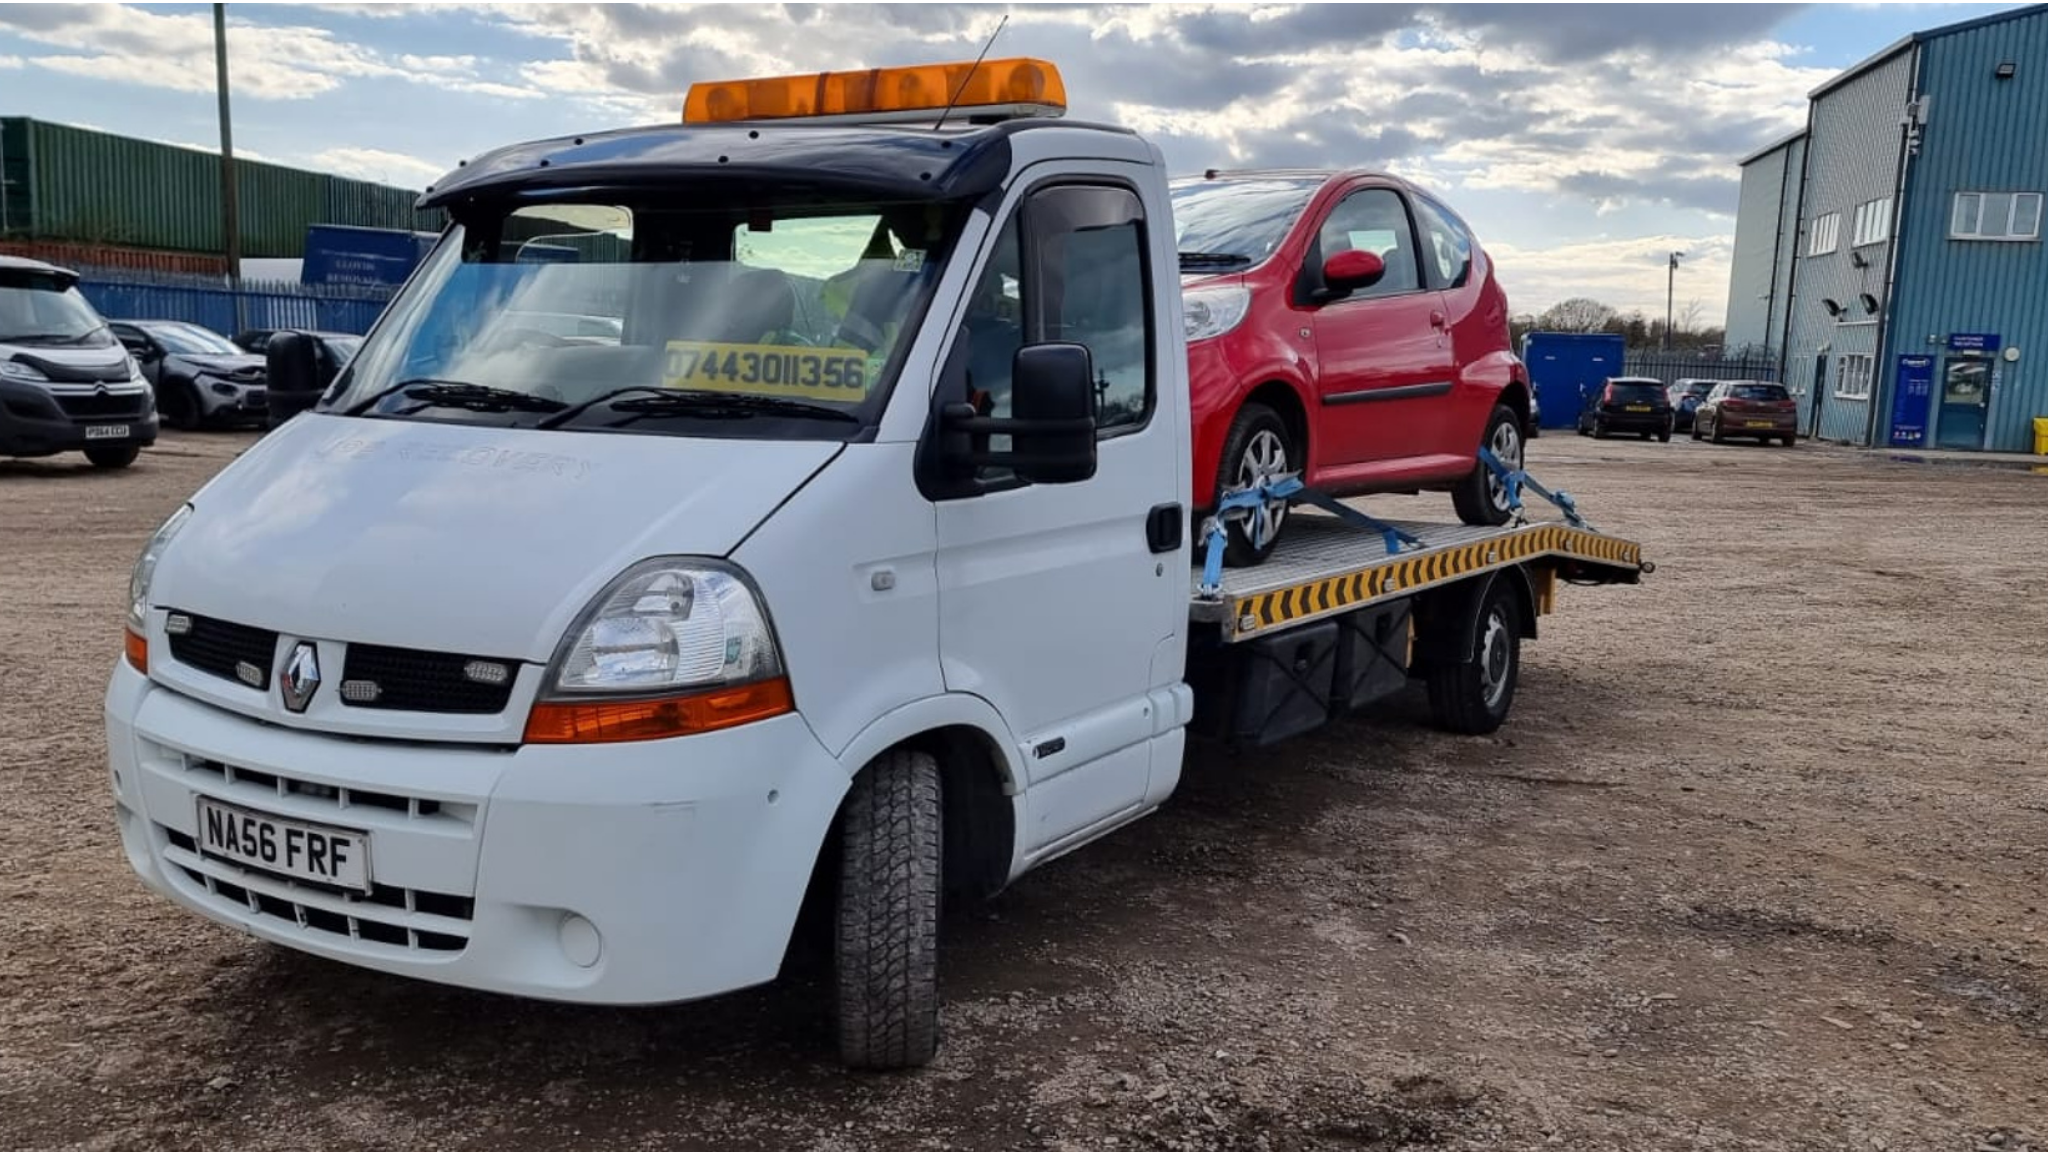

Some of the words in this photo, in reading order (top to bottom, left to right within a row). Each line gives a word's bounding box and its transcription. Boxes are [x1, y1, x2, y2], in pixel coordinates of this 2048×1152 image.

[665, 348, 864, 389] 07443011356
[207, 806, 277, 863] NA56
[286, 827, 351, 877] FRF
